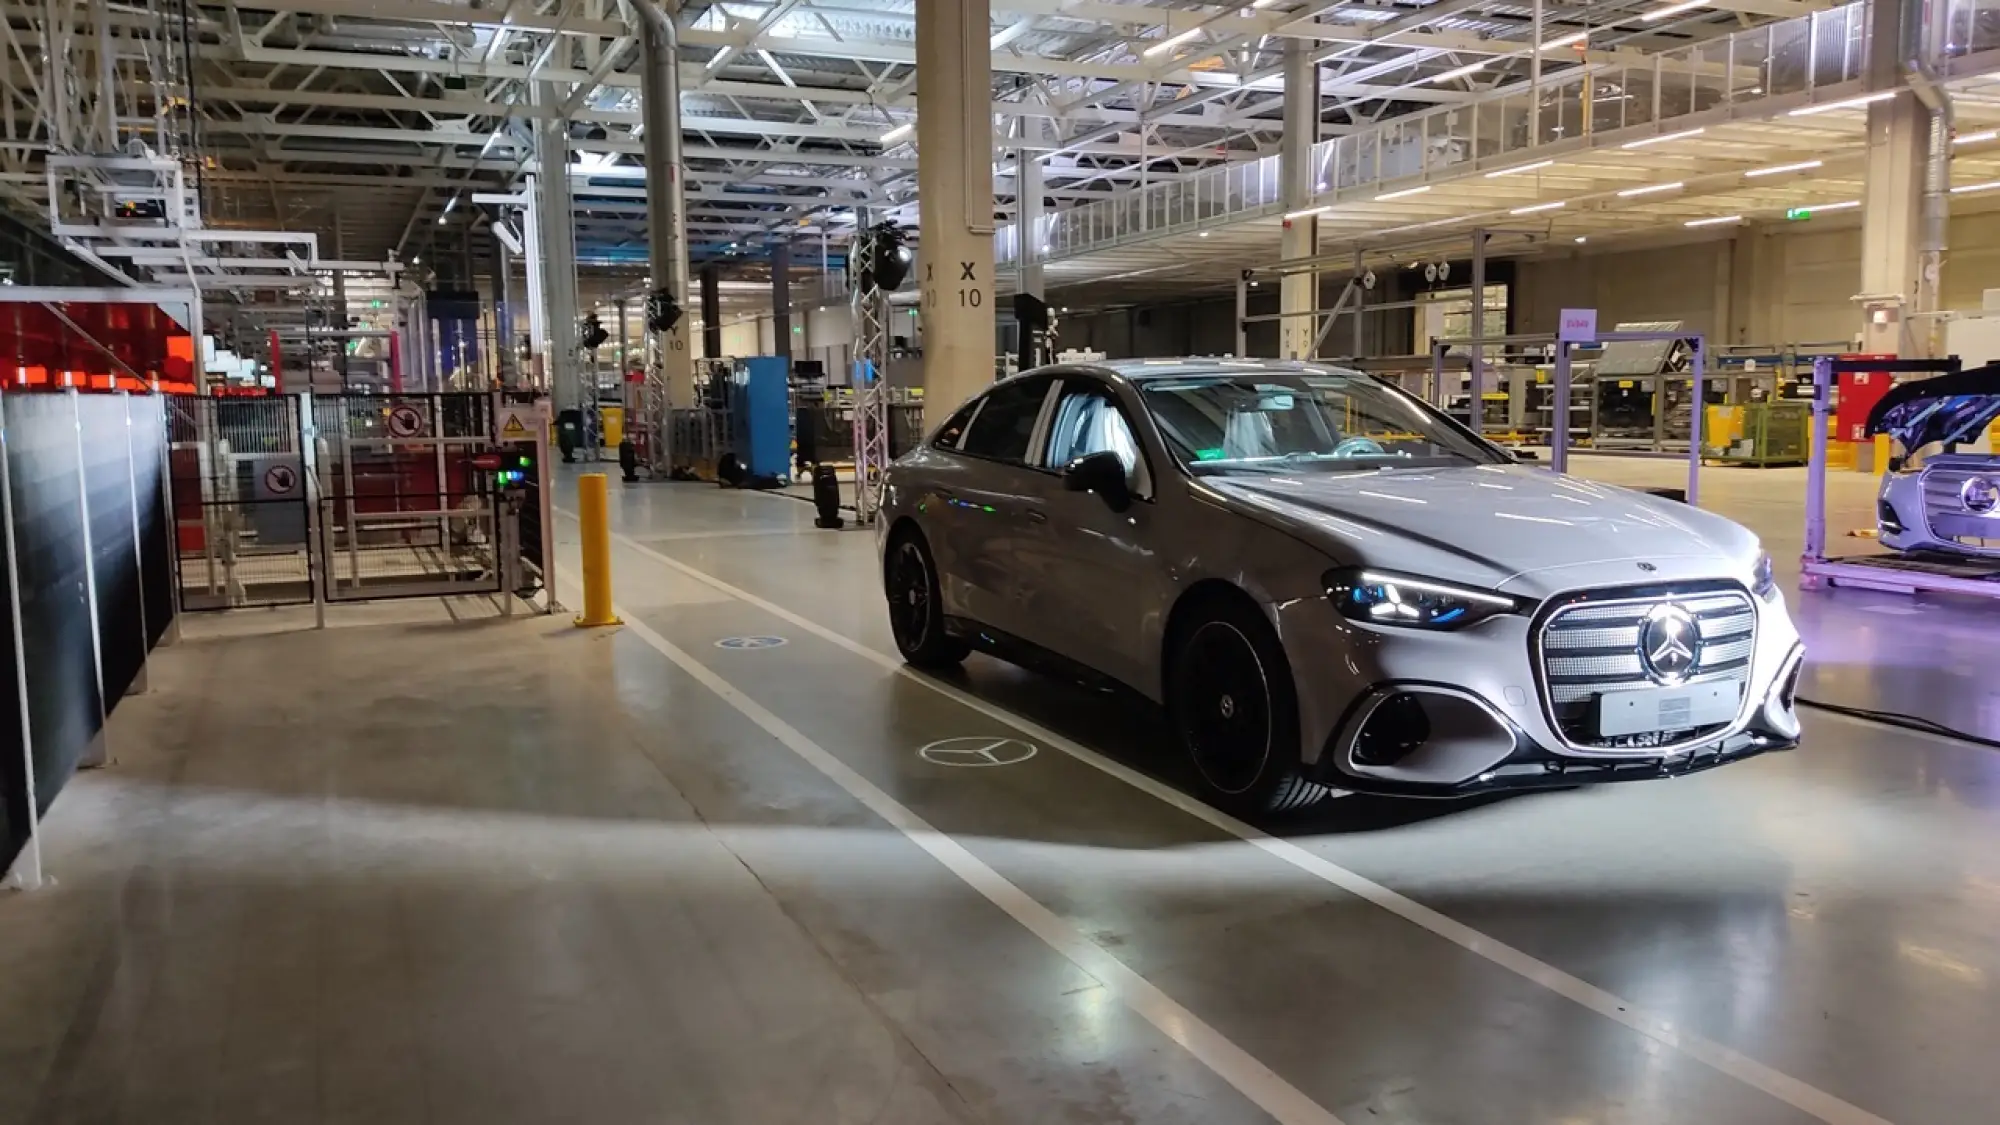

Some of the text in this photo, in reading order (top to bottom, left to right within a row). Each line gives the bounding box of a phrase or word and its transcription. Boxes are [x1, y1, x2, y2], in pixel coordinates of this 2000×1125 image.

[960, 261, 976, 280] X
[958, 288, 981, 307] 10
[669, 340, 684, 351] 10
